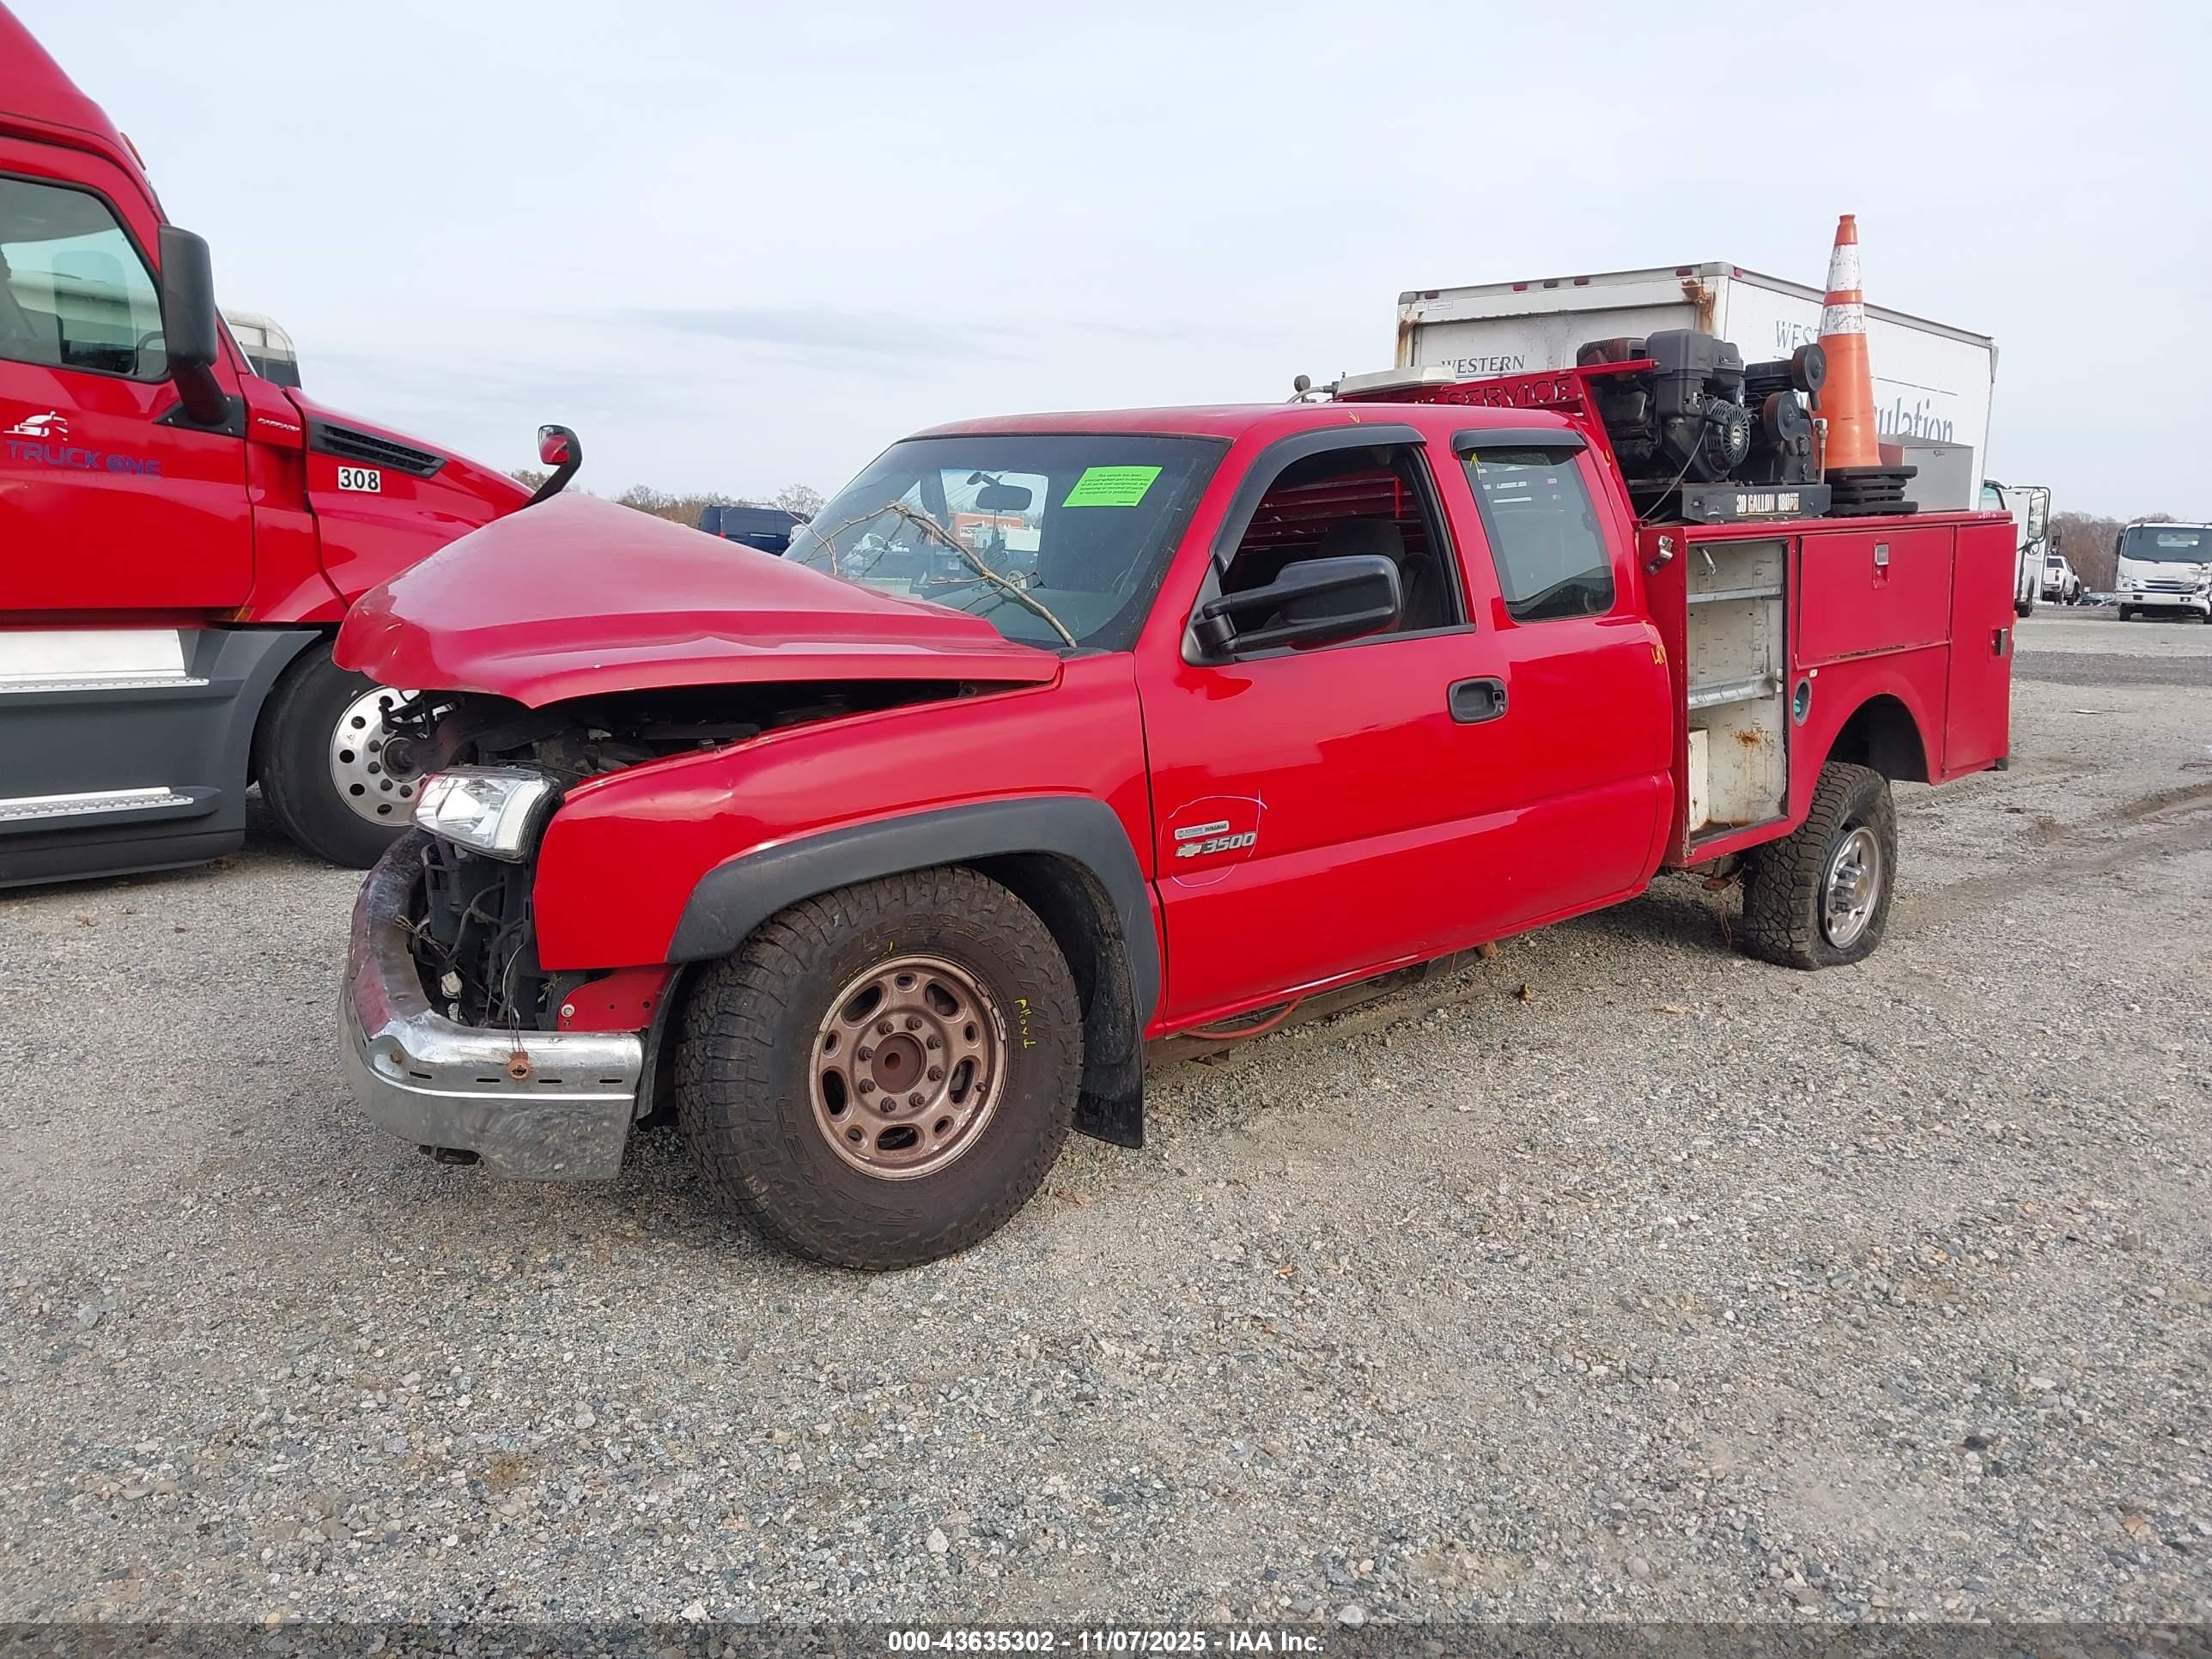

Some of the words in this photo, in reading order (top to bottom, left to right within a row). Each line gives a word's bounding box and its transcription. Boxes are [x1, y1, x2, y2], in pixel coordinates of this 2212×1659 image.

[1442, 355, 1526, 374] WESTERN
[1448, 377, 1571, 408] SERVICE
[6, 440, 101, 469] TRUCK
[106, 453, 161, 477] ONE
[340, 469, 379, 490] 308
[1736, 494, 1747, 514] 30
[1748, 494, 1775, 513] GALLON
[1202, 831, 1256, 854] 3500
